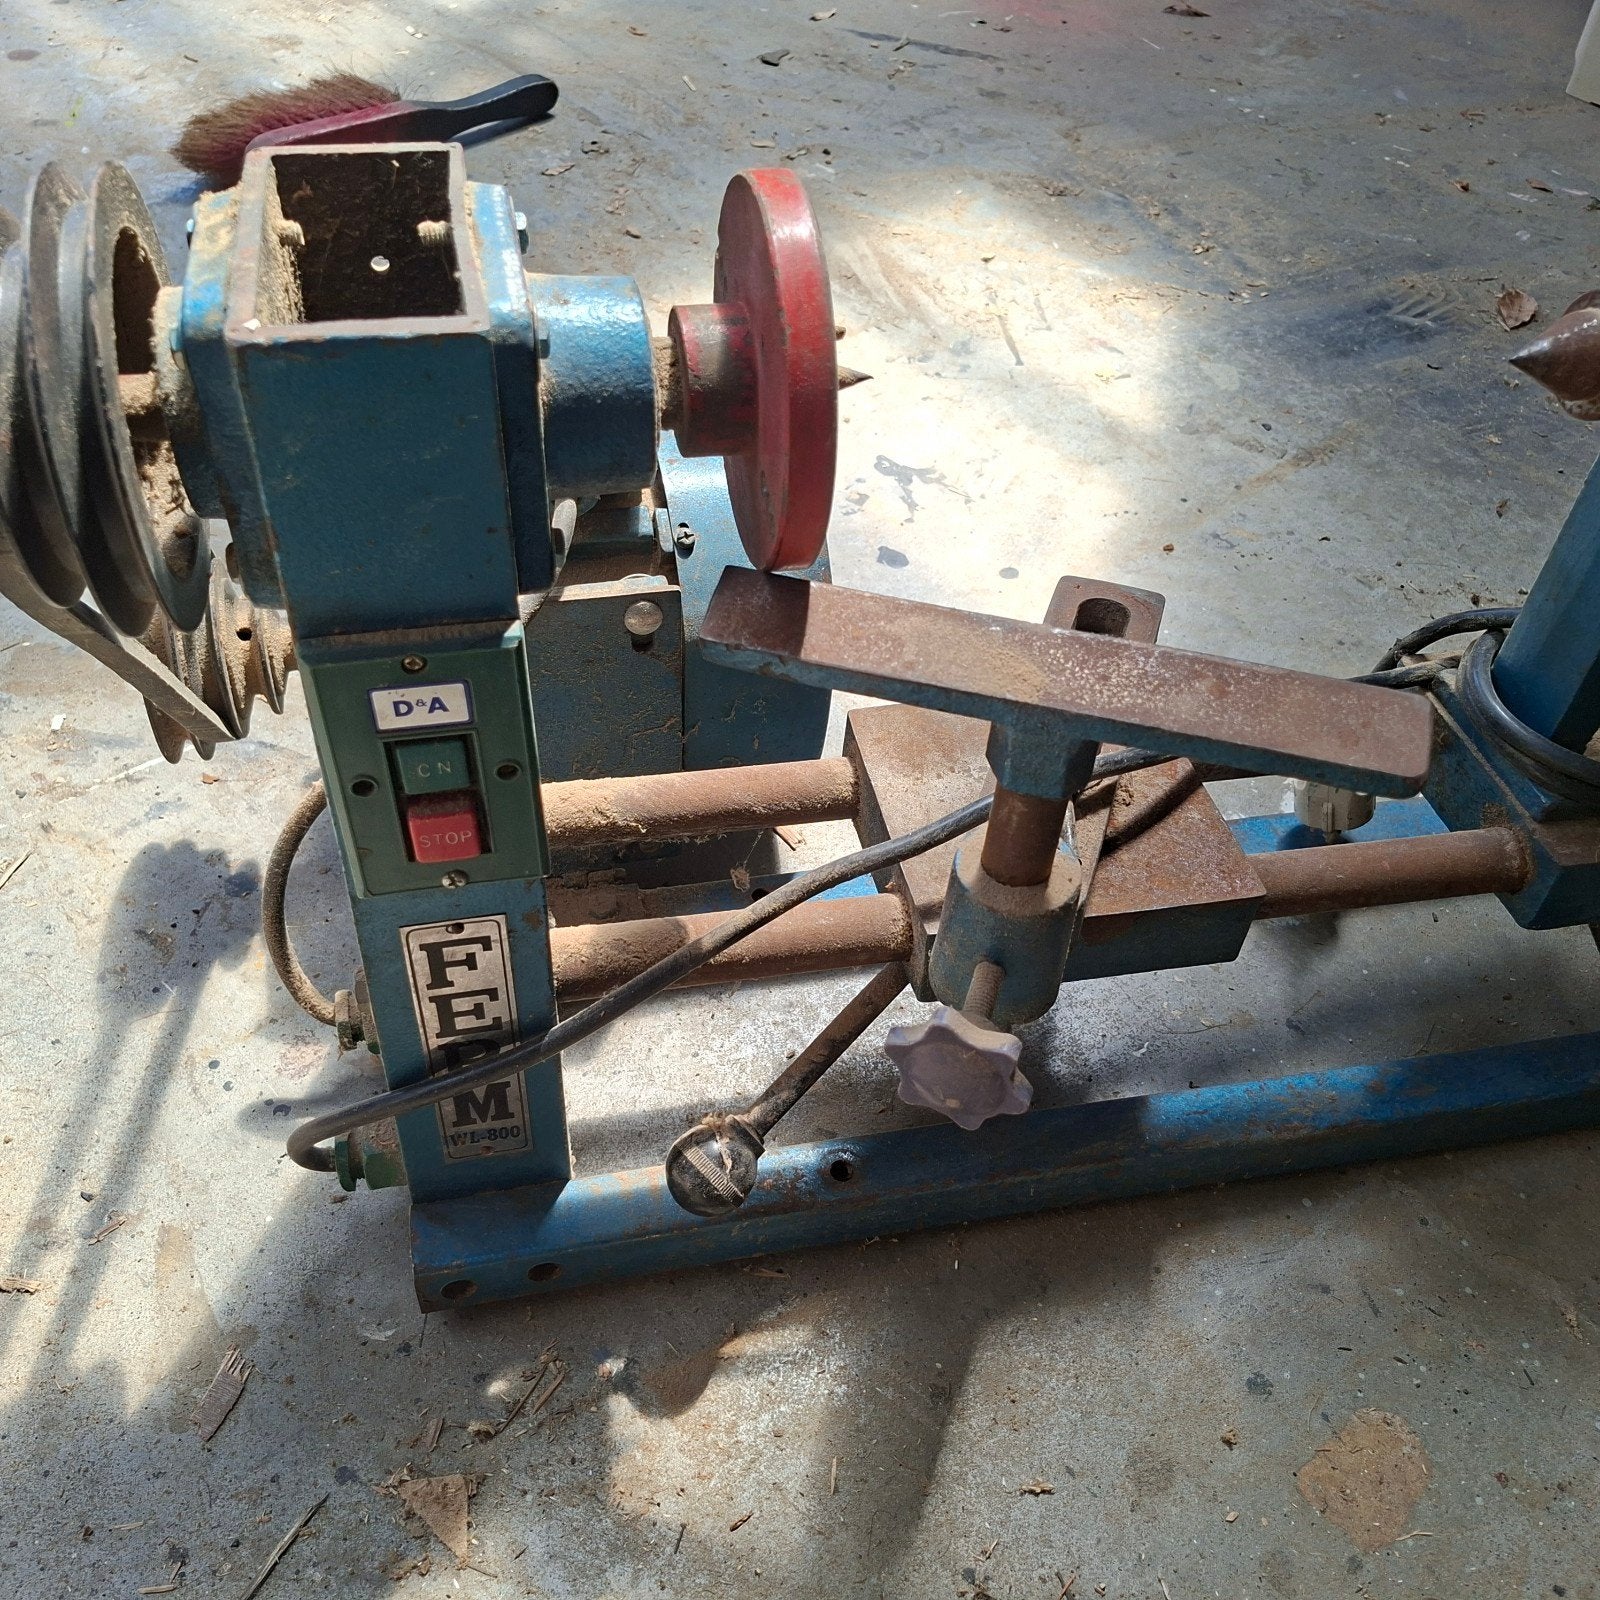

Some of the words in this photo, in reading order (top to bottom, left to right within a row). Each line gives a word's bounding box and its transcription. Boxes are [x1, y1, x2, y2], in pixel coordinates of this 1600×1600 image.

[392, 696, 450, 717] D&A
[420, 830, 472, 848] STOP
[449, 1125, 520, 1146] WL-800
